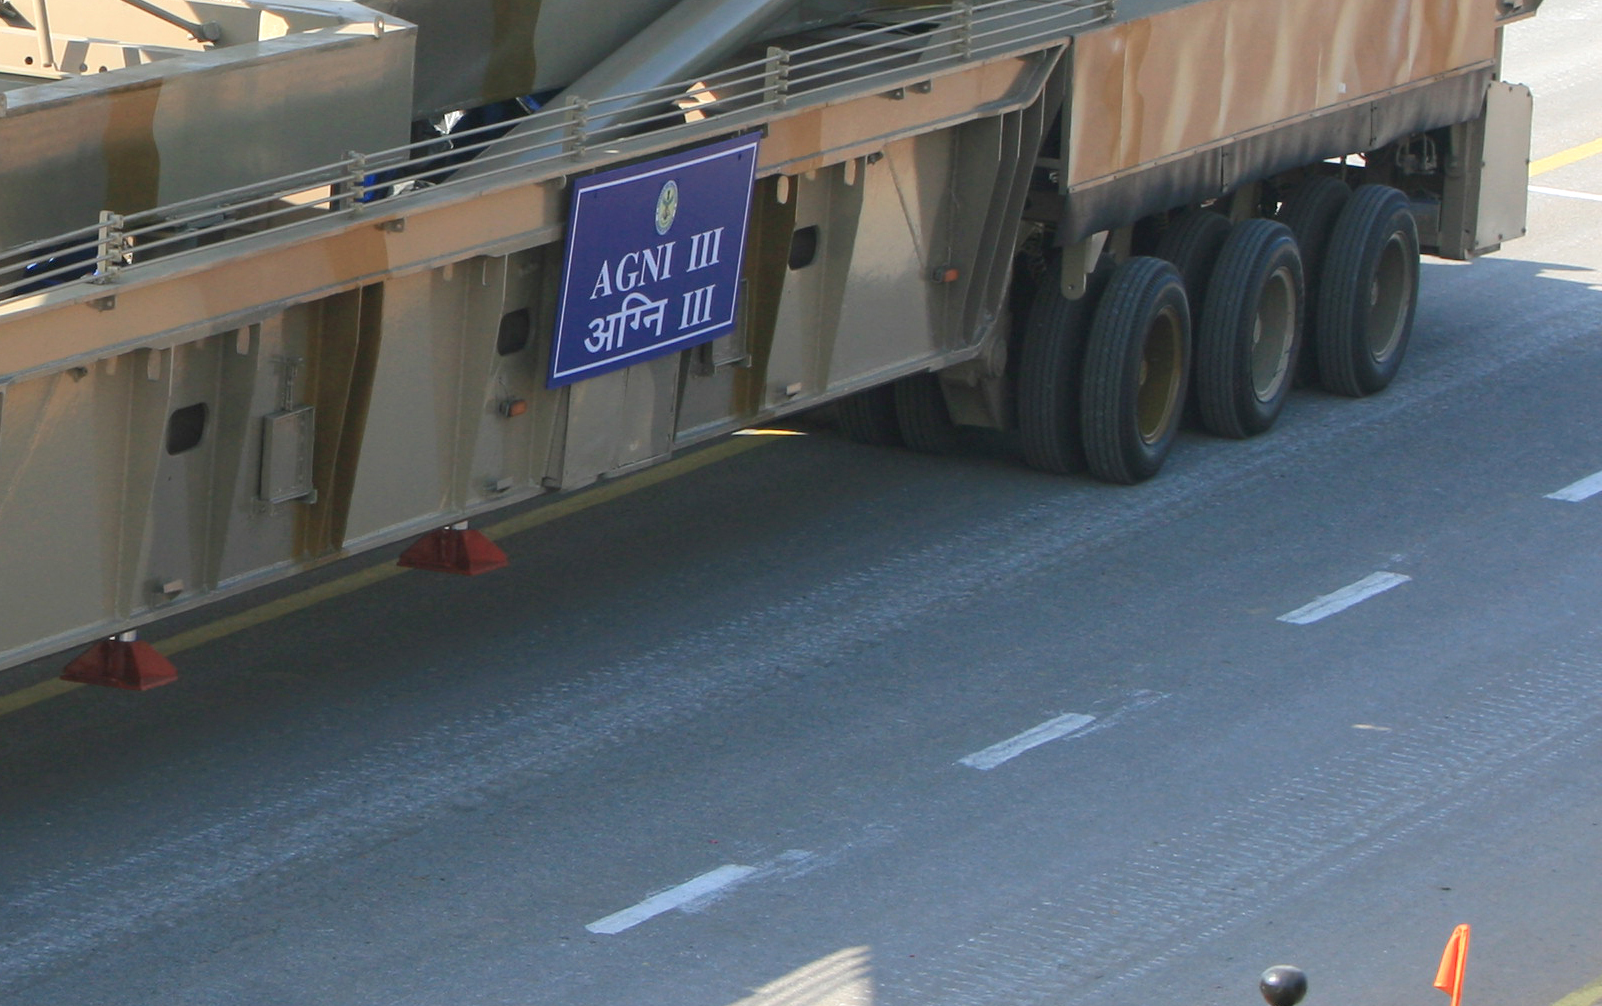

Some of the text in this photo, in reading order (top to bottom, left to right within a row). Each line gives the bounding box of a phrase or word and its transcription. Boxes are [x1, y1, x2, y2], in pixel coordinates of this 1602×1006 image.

[589, 226, 725, 300] AGNI III
[583, 284, 716, 354] अग्नि III
